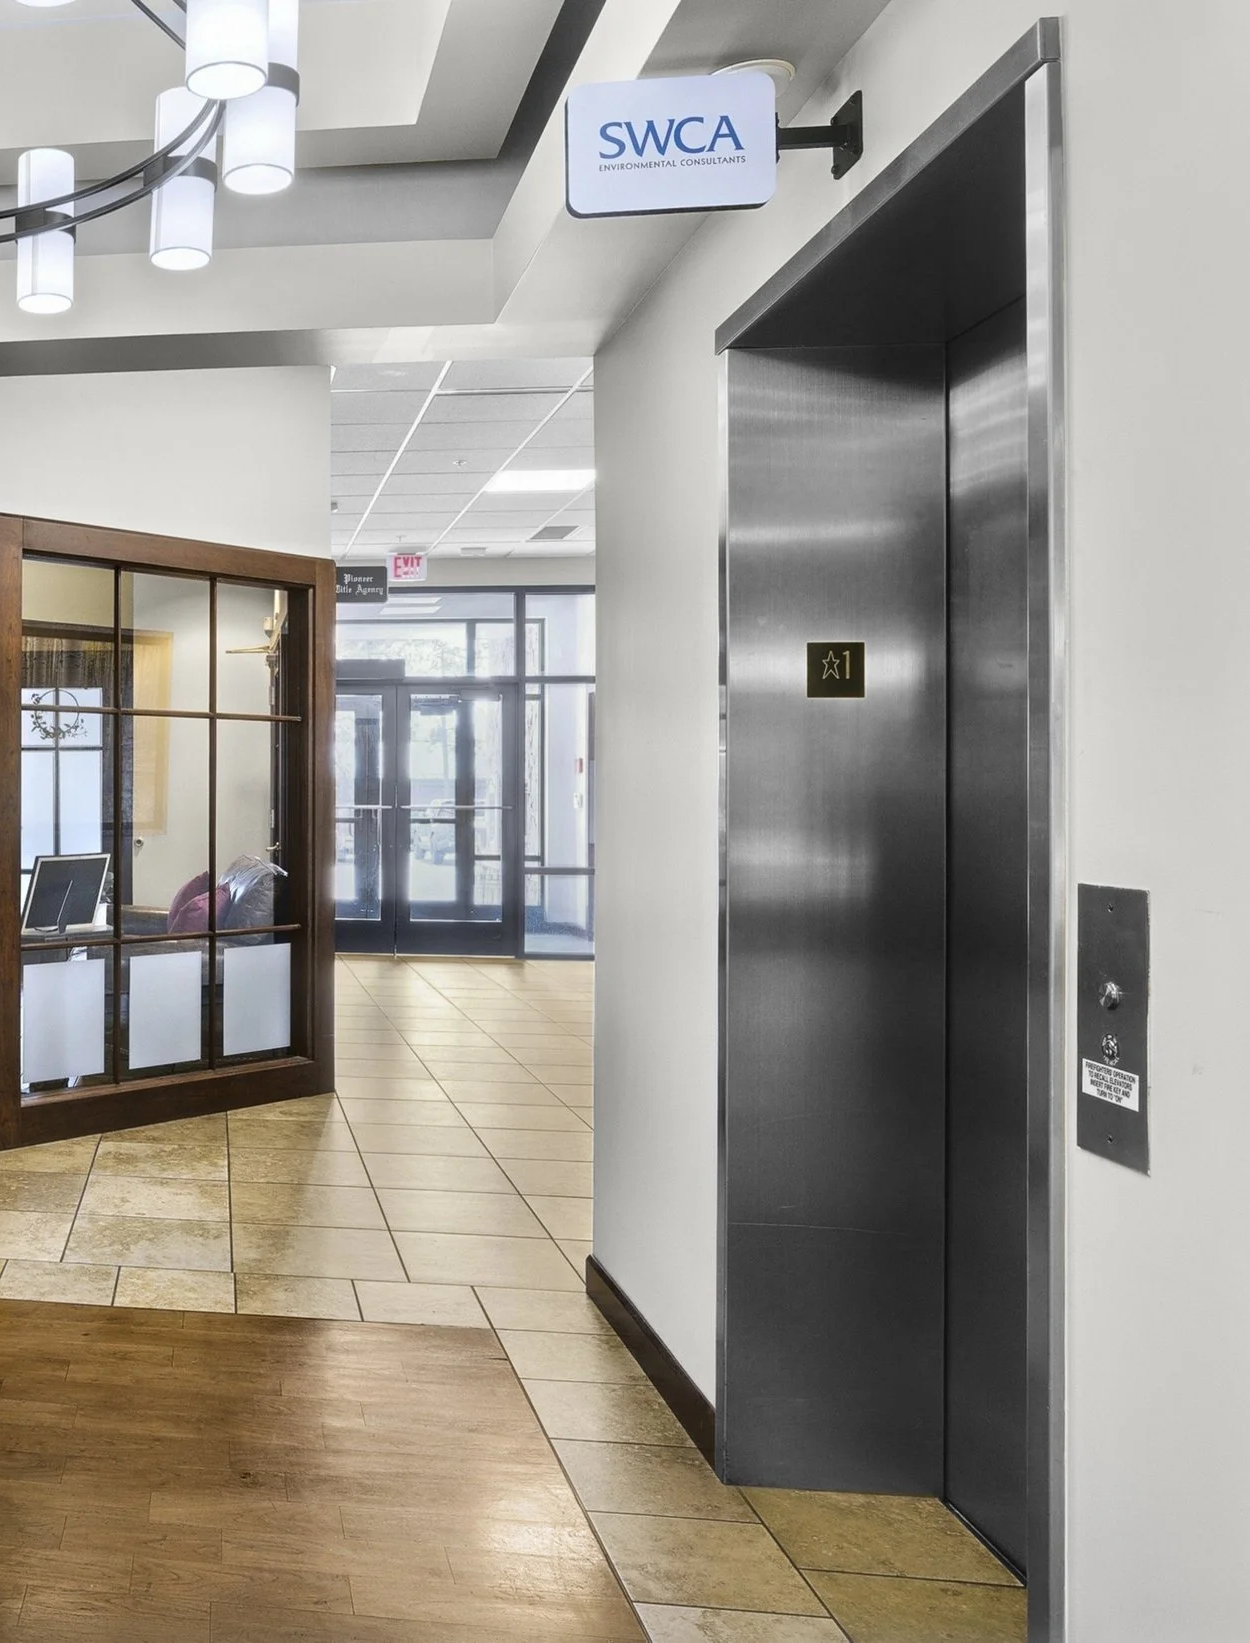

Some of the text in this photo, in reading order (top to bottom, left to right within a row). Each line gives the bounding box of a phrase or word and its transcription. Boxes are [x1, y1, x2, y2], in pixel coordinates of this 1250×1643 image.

[599, 115, 745, 160] SWCA
[599, 155, 746, 172] ENVIRONMENTAL CONSULTANTS
[394, 556, 422, 577] EXIT
[343, 573, 374, 585] Pioneer
[355, 584, 384, 596] Agency
[1088, 1070, 1133, 1091] TO RECALL ELEVATORS
[1113, 1070, 1136, 1084] OPERATION
[1090, 1078, 1131, 1099] INSERT FIRE KEY AND
[1097, 1088, 1108, 1098] TURN
[1108, 1092, 1114, 1101] TO
